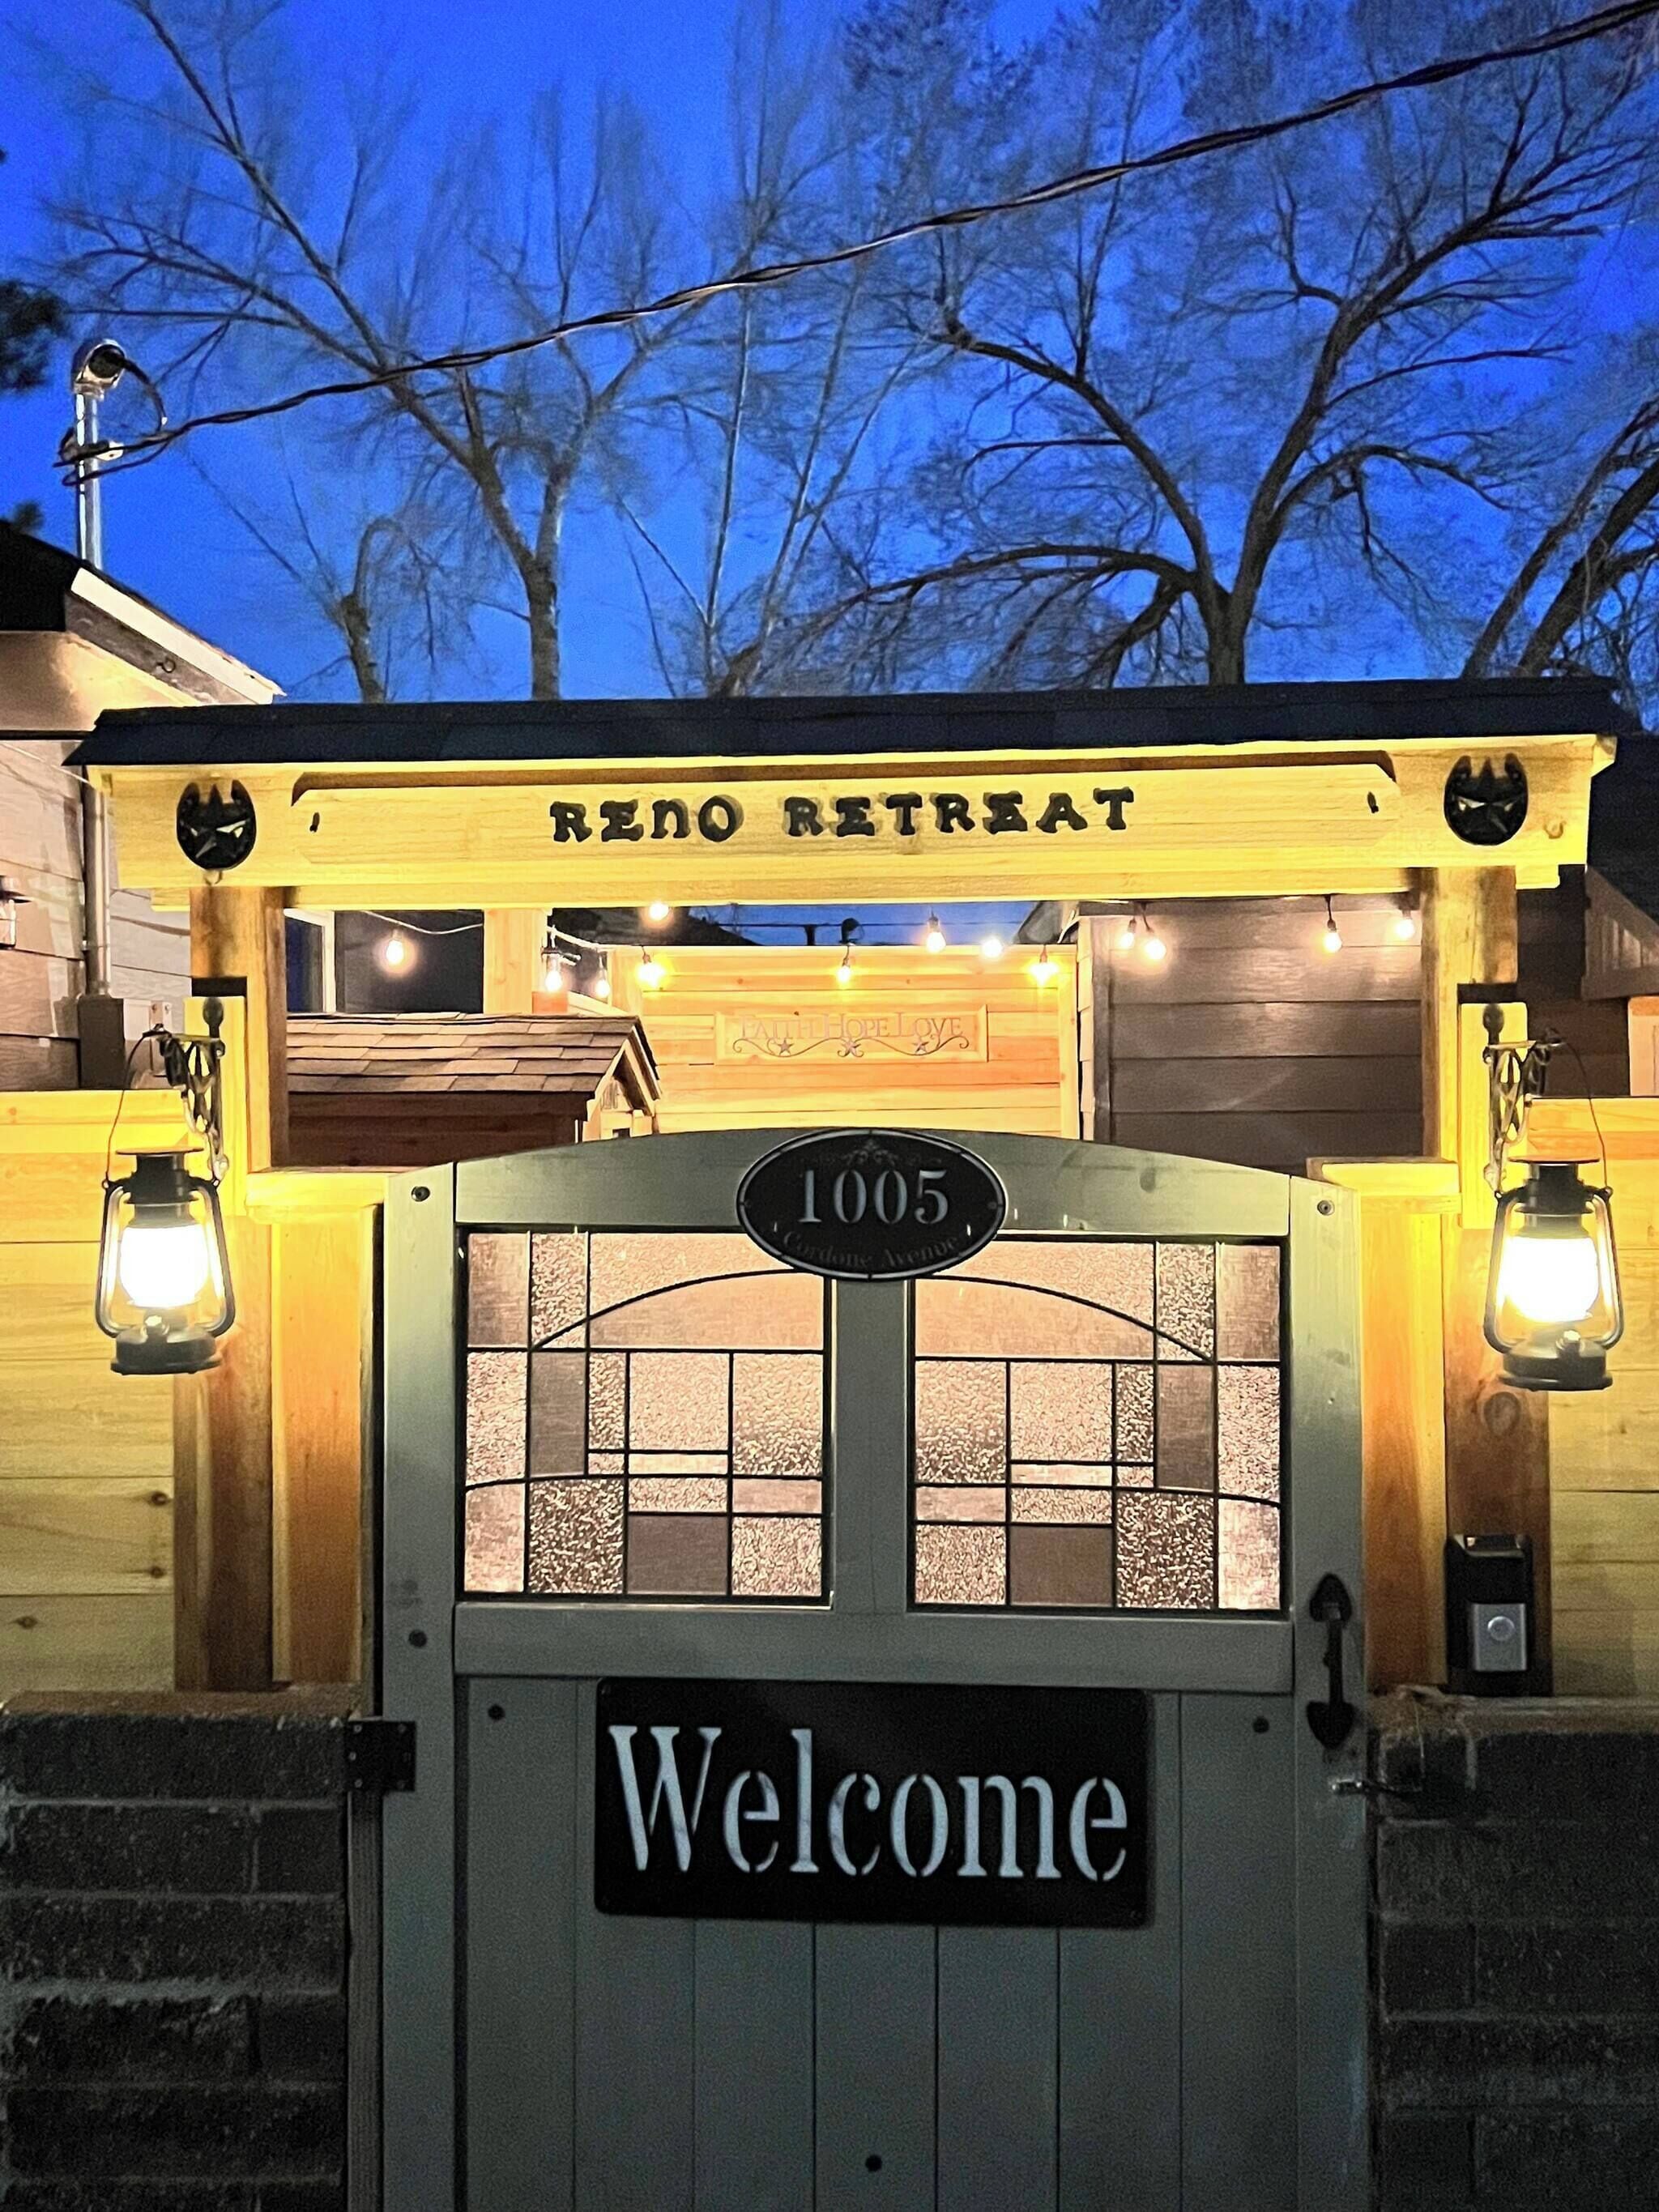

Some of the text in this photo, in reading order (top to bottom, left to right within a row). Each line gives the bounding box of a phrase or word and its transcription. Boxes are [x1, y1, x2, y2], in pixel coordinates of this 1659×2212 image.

[784, 787, 1134, 837] RETREAT
[821, 1012, 890, 1039] HOPE
[895, 1012, 964, 1040] LOVE
[798, 1170, 949, 1224] 1005
[881, 1235, 958, 1268] Avenue
[608, 1724, 1128, 1882] Welcome
